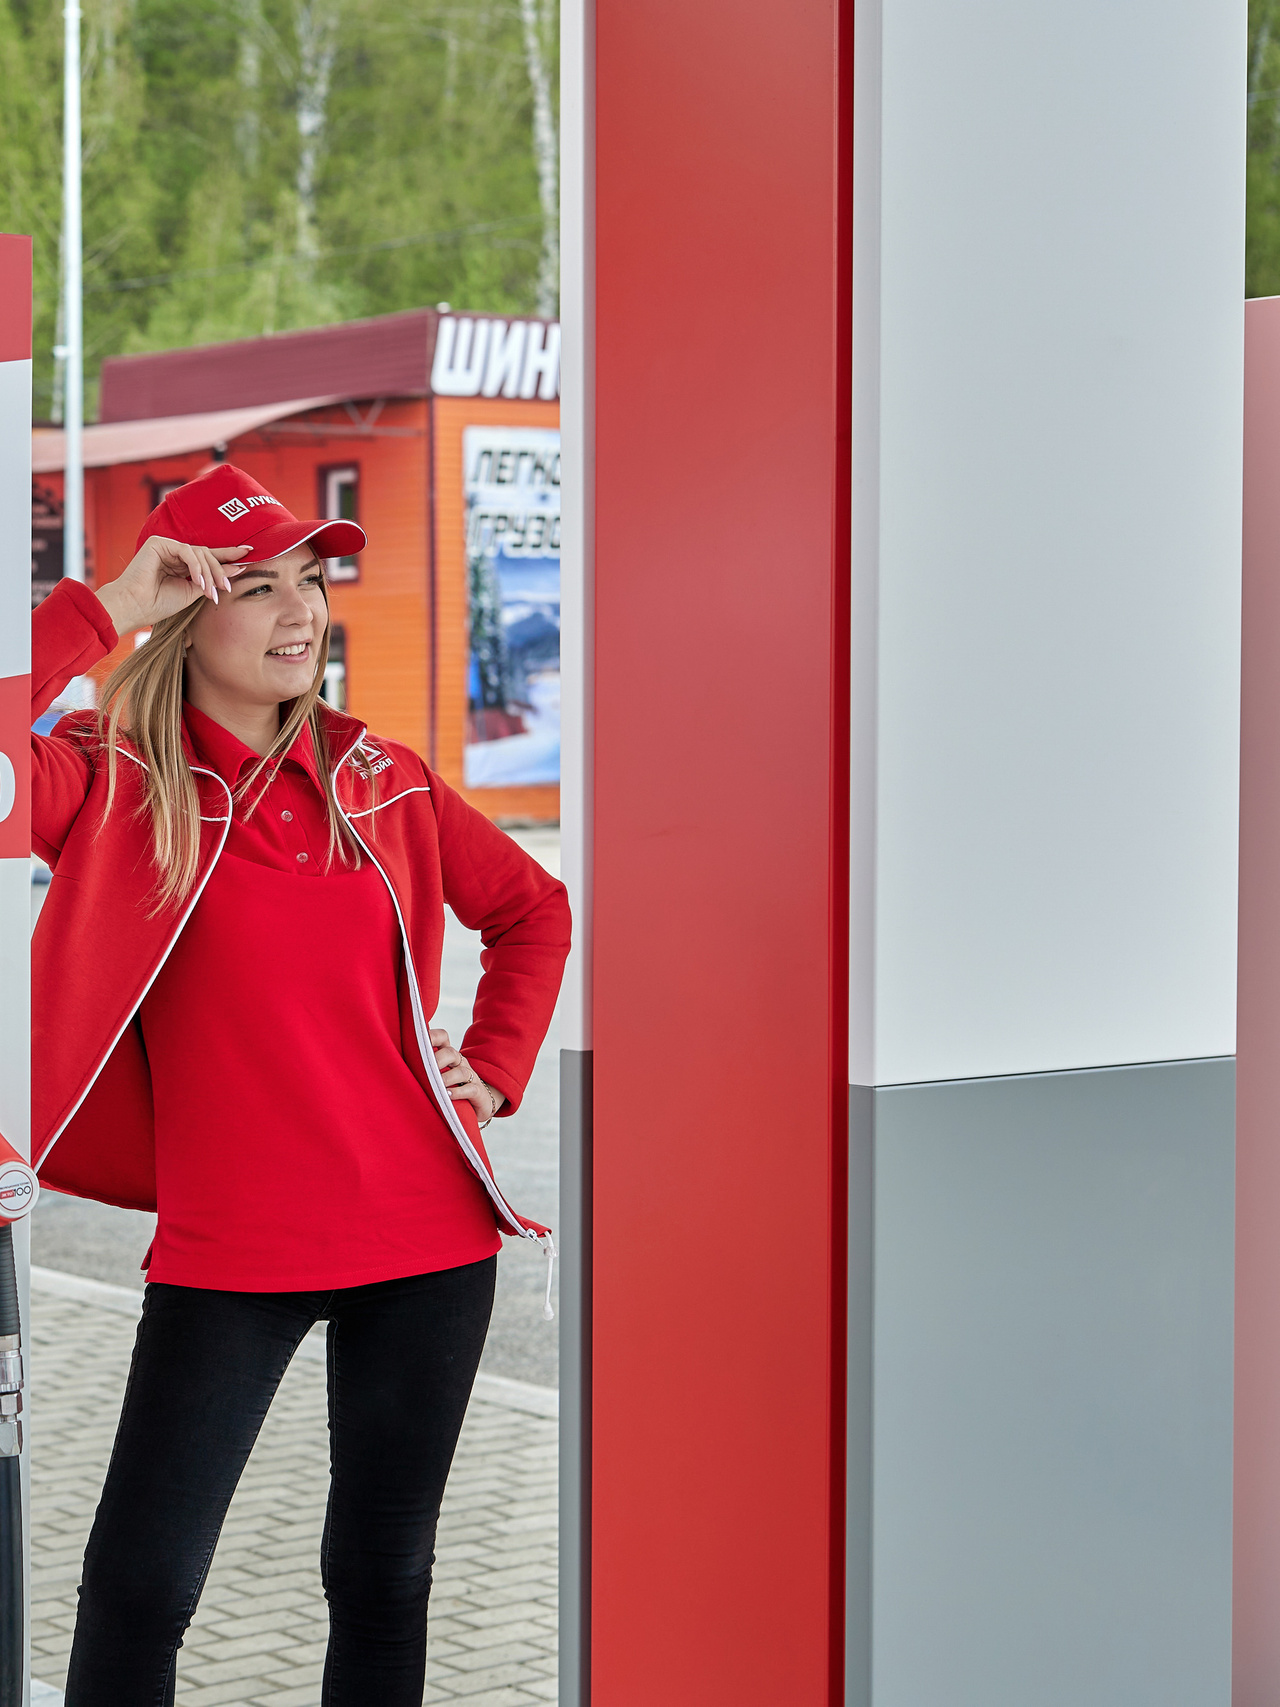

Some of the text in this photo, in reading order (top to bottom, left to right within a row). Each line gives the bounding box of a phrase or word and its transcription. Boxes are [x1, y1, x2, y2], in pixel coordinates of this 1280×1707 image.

[431, 316, 560, 400] ШИН
[246, 495, 284, 507] ЛУК
[360, 757, 394, 780] ЛОЙЛ
